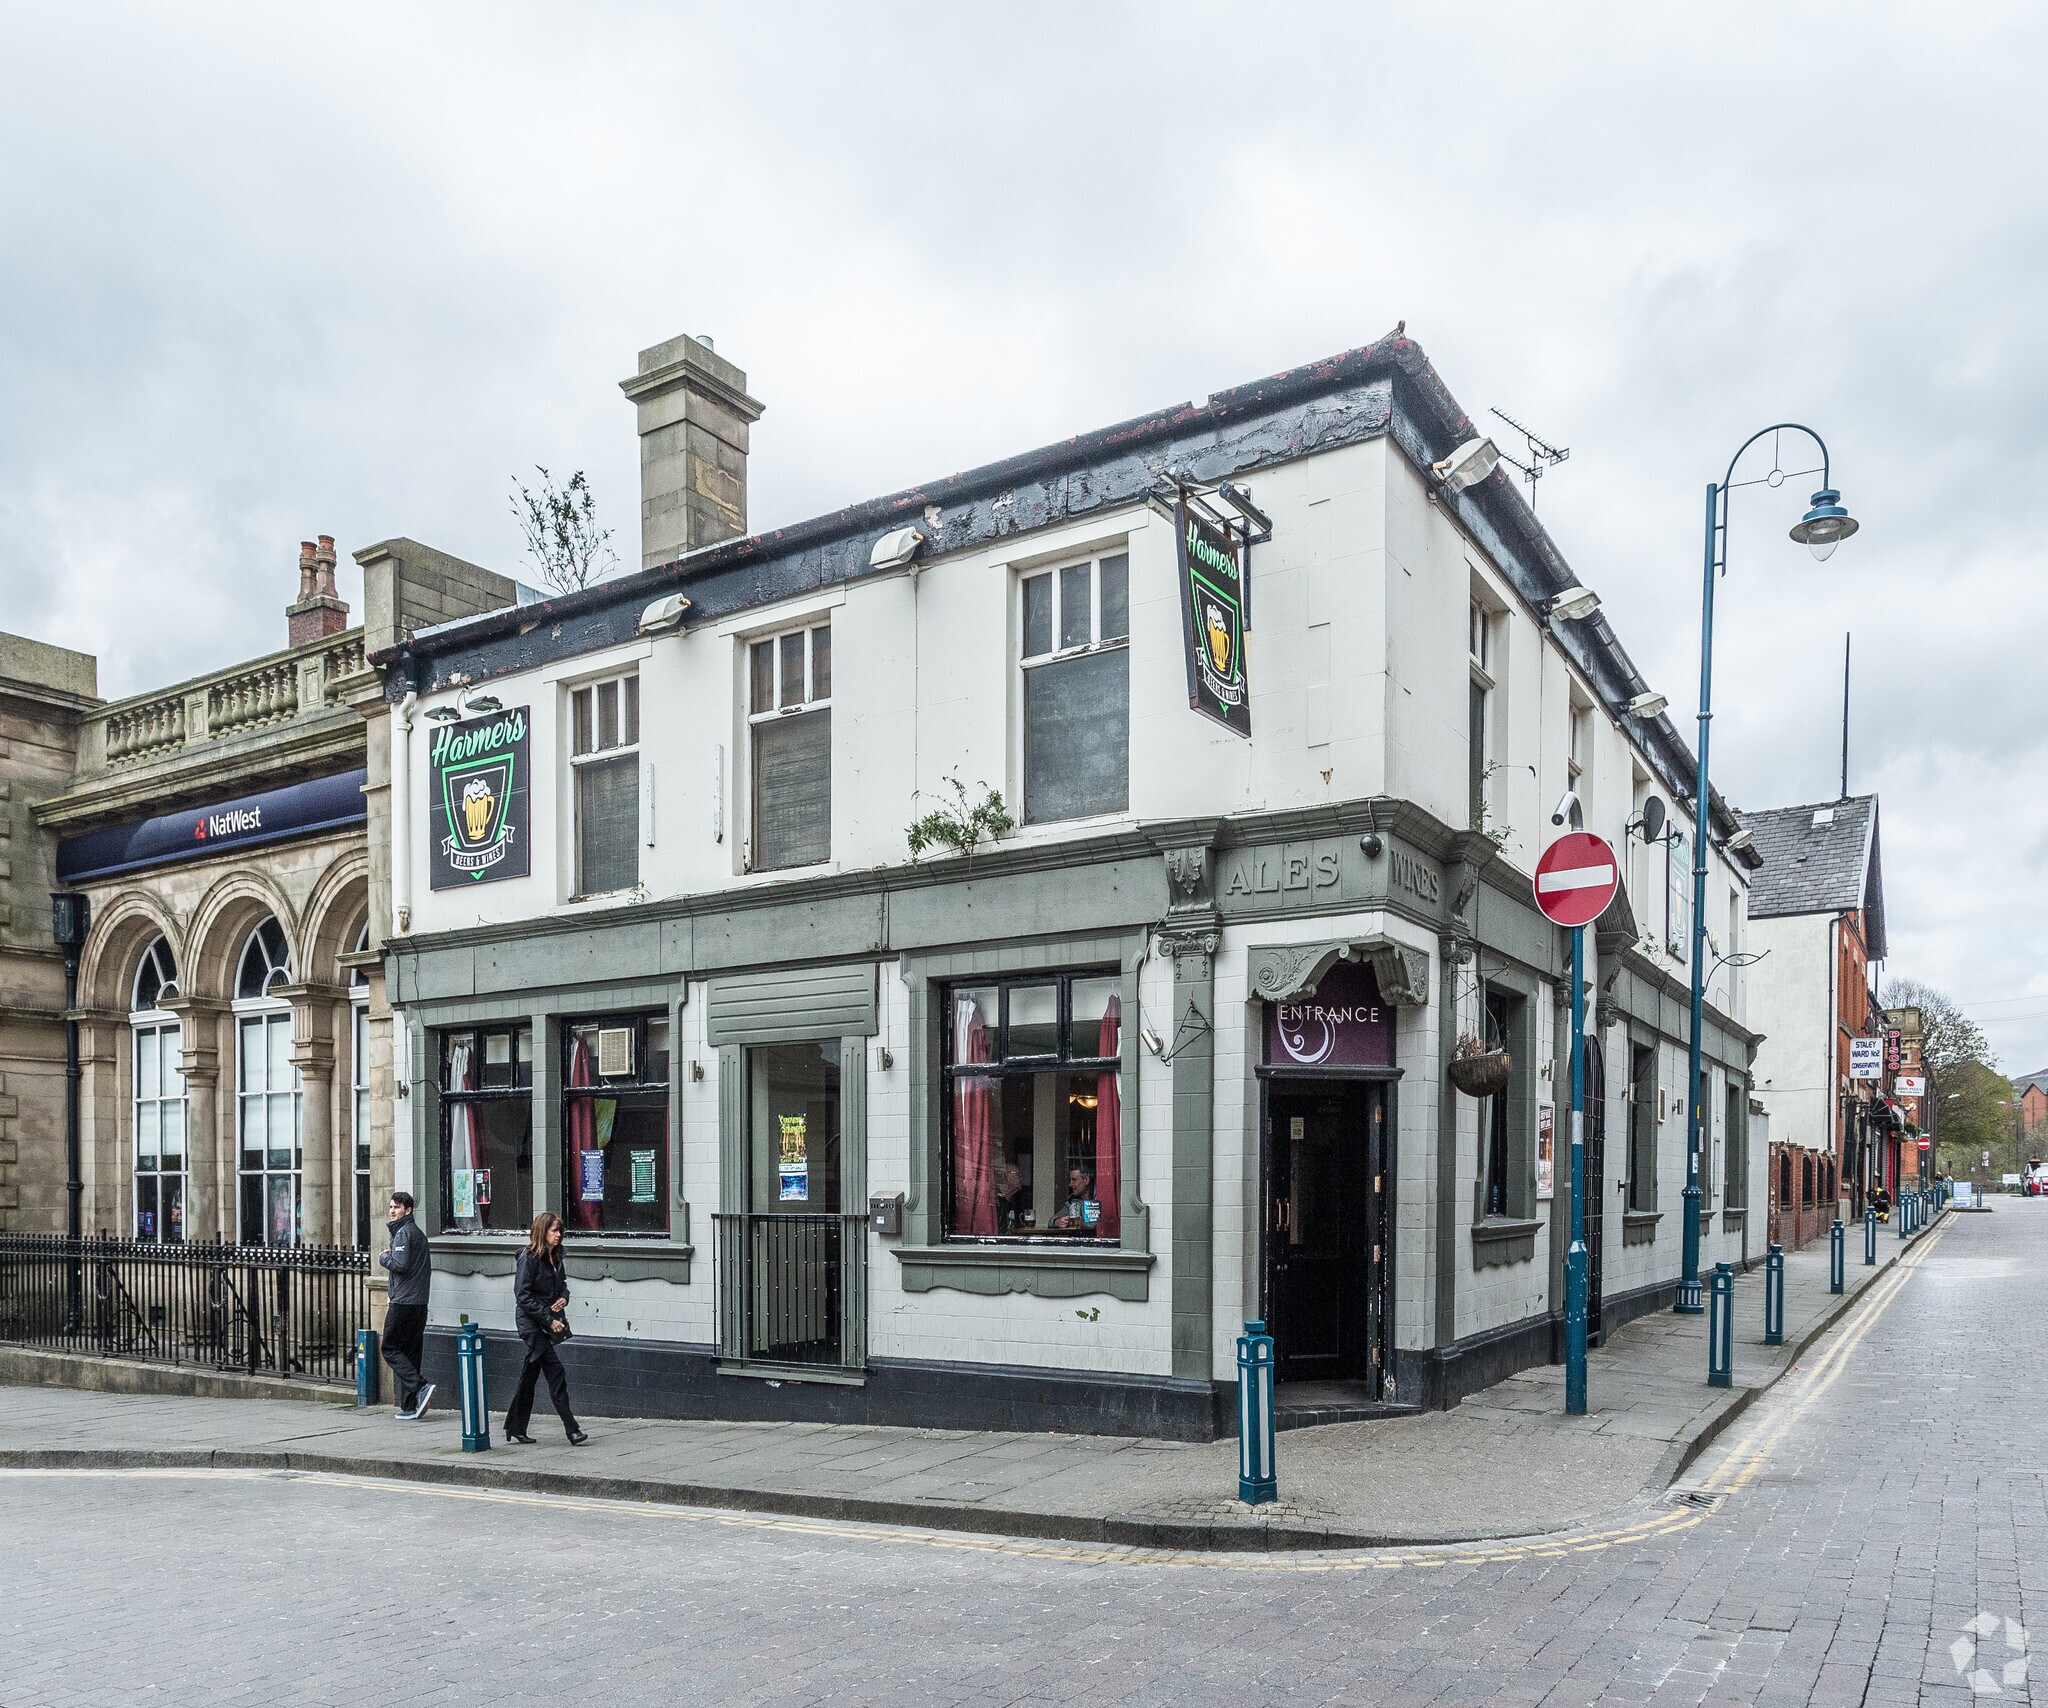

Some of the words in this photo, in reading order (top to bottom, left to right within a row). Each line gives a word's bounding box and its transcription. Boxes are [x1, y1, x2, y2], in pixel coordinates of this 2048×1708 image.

[1186, 519, 1238, 580] Harmer's
[431, 708, 526, 768] Harmer's
[209, 805, 262, 837] NatWest
[455, 855, 475, 867] BEERS
[481, 847, 500, 865] WINES
[1226, 852, 1340, 896] ALES
[1390, 850, 1440, 903] WINES
[1279, 1005, 1379, 1023] ENTRANCE
[1851, 1050, 1869, 1058] WARD
[1855, 1040, 1877, 1049] STALEY
[1888, 1030, 1901, 1070] DISCO
[1851, 1061, 1880, 1069] CONSERVATIVE
